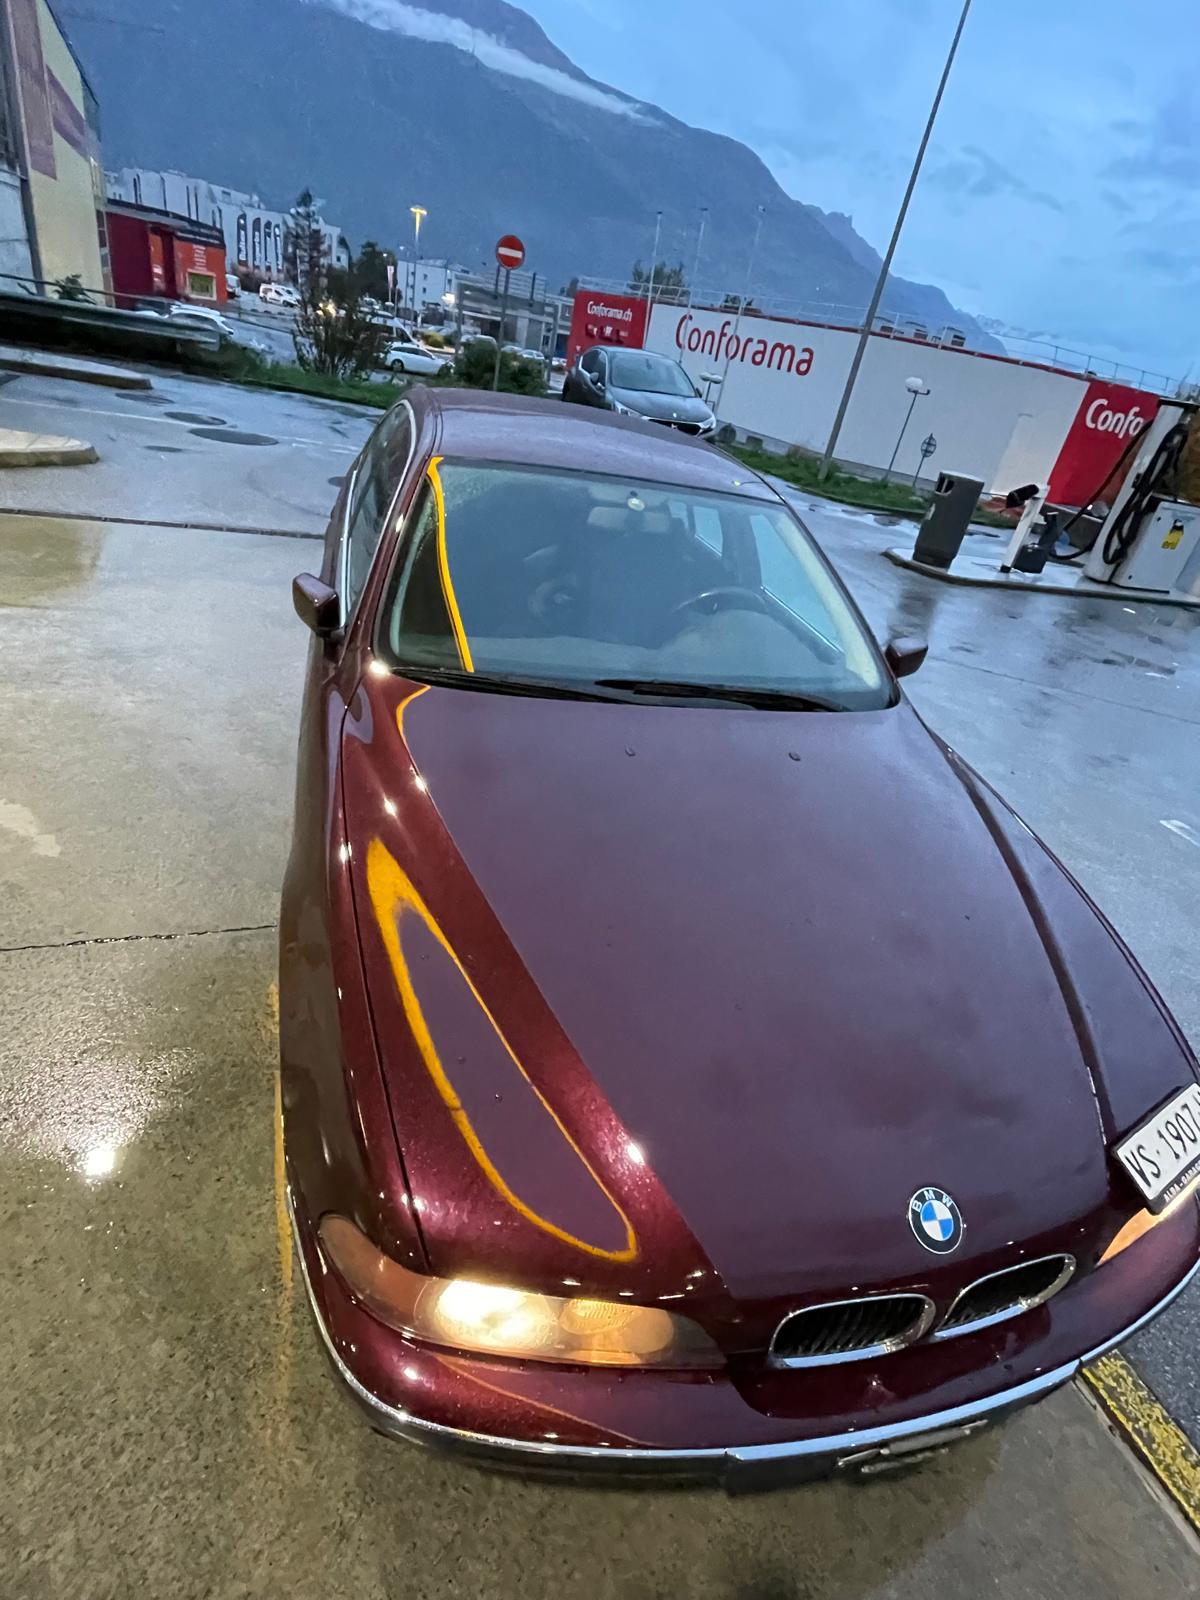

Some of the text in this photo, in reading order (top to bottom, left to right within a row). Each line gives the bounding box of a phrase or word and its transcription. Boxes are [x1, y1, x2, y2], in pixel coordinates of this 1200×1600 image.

[587, 300, 633, 322] Conforama.ch
[675, 313, 815, 377] Conforama
[1085, 398, 1144, 439] Confo
[911, 1189, 954, 1212] BMW
